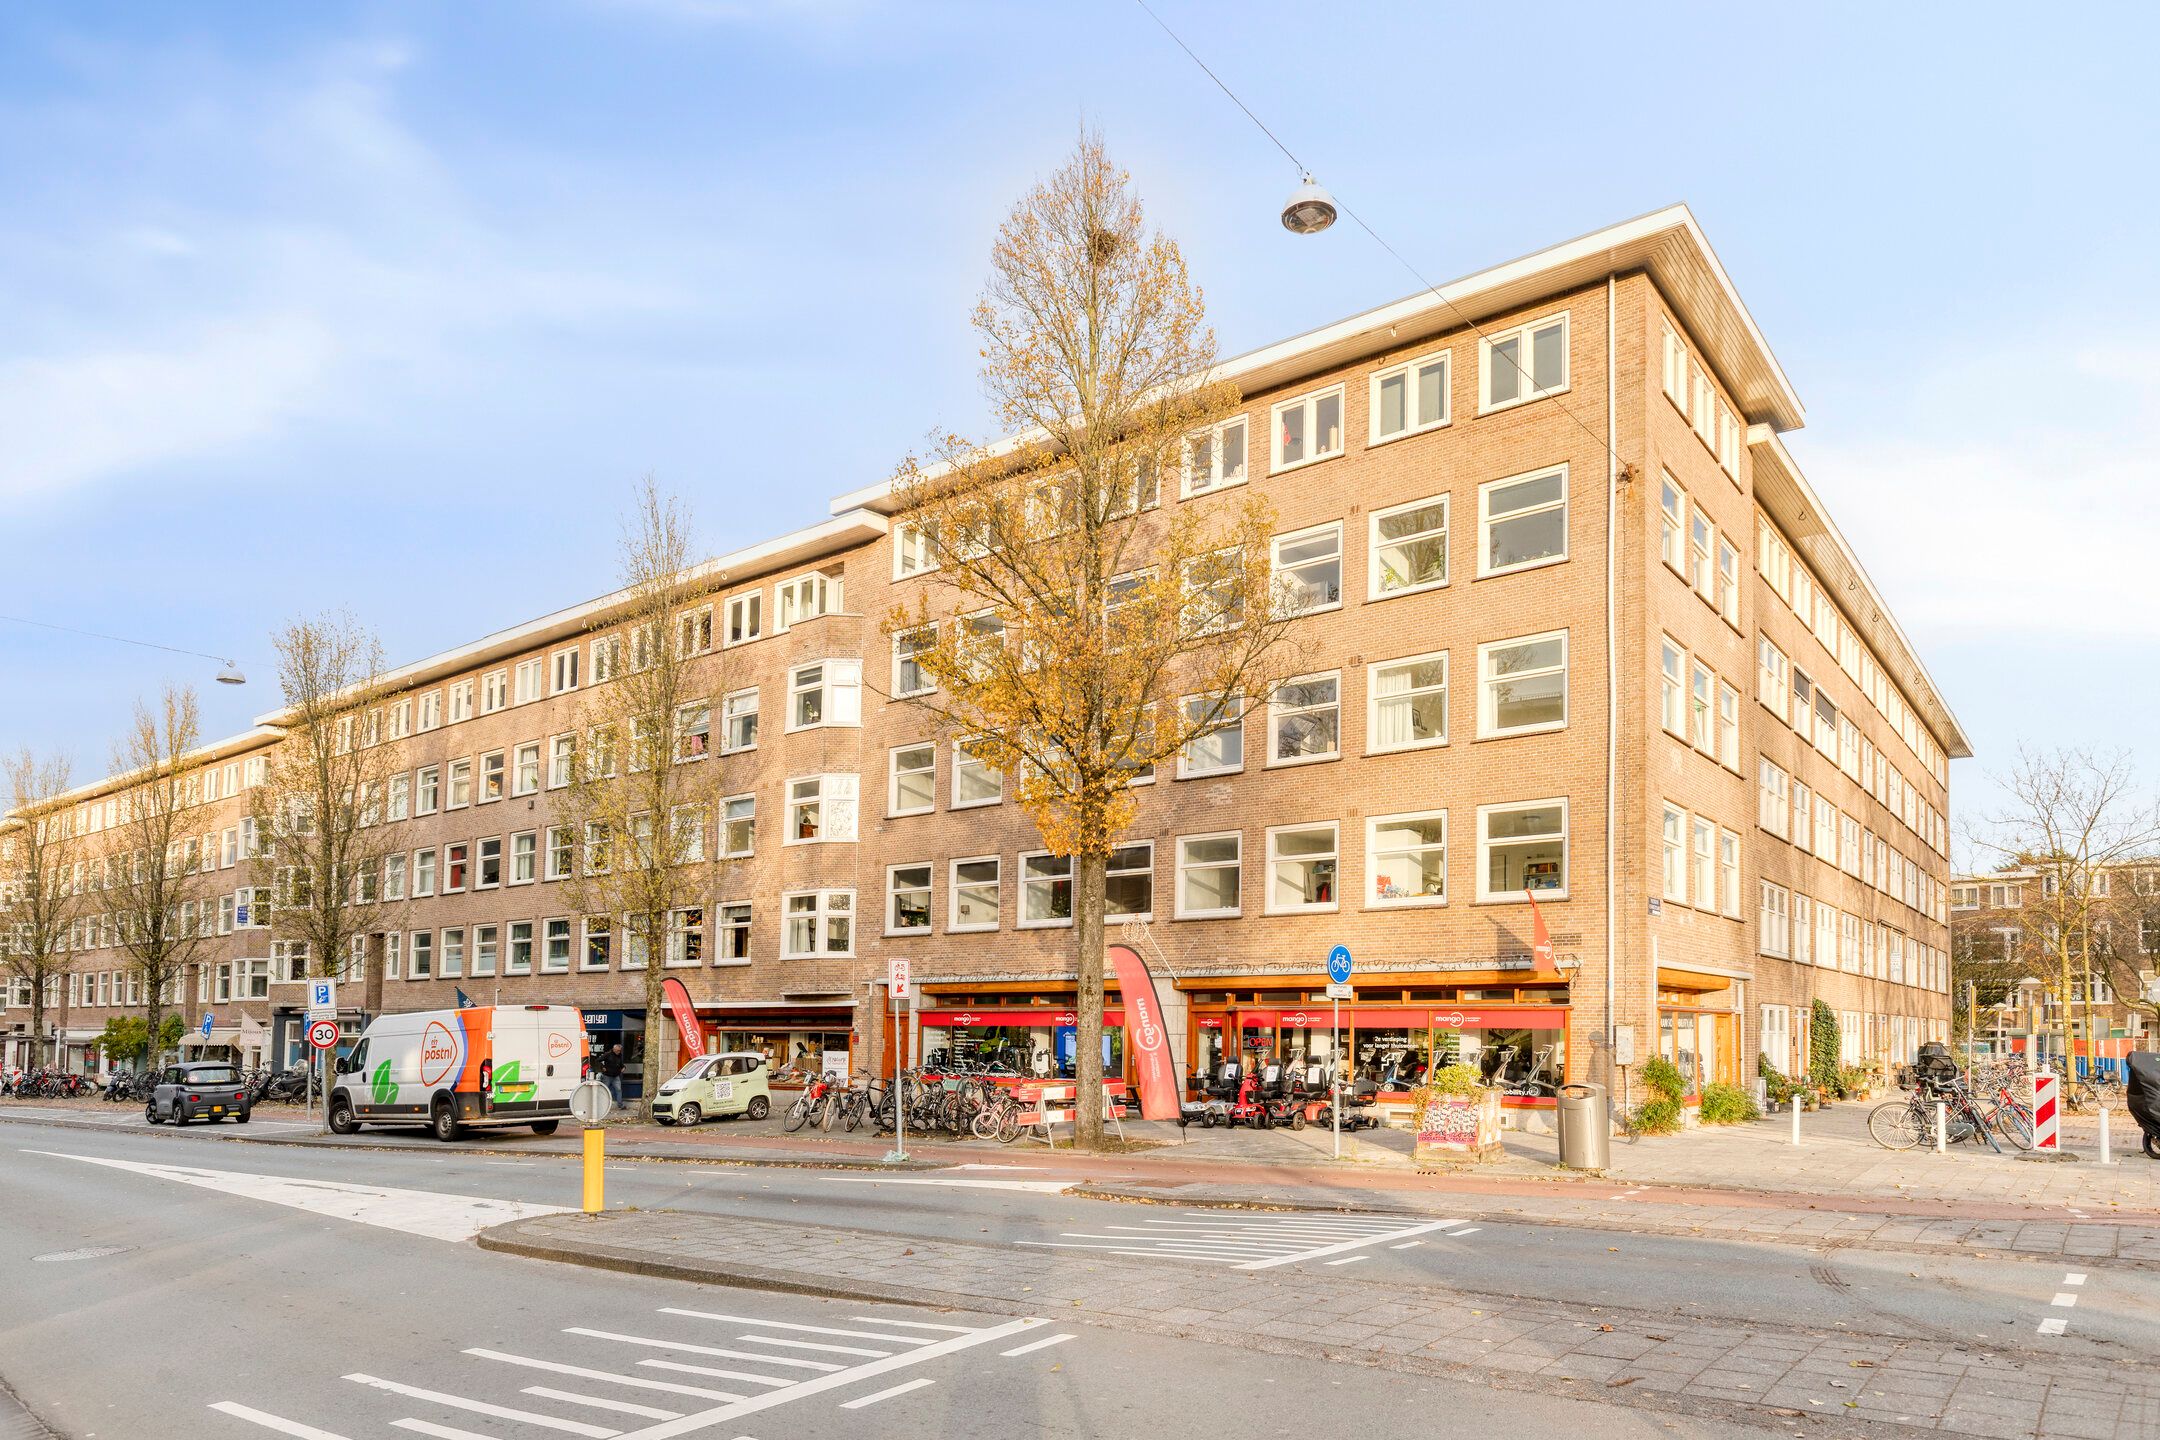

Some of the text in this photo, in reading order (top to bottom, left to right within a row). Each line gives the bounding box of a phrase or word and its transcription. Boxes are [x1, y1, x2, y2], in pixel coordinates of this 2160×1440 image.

[318, 986, 326, 997] P
[206, 1015, 212, 1023] P
[1282, 1016, 1305, 1024] mango
[1435, 1016, 1462, 1024] mango
[315, 1028, 334, 1041] 30
[1249, 1037, 1273, 1047] OPEN
[1374, 1042, 1390, 1050] langer
[425, 1044, 453, 1064] postnl
